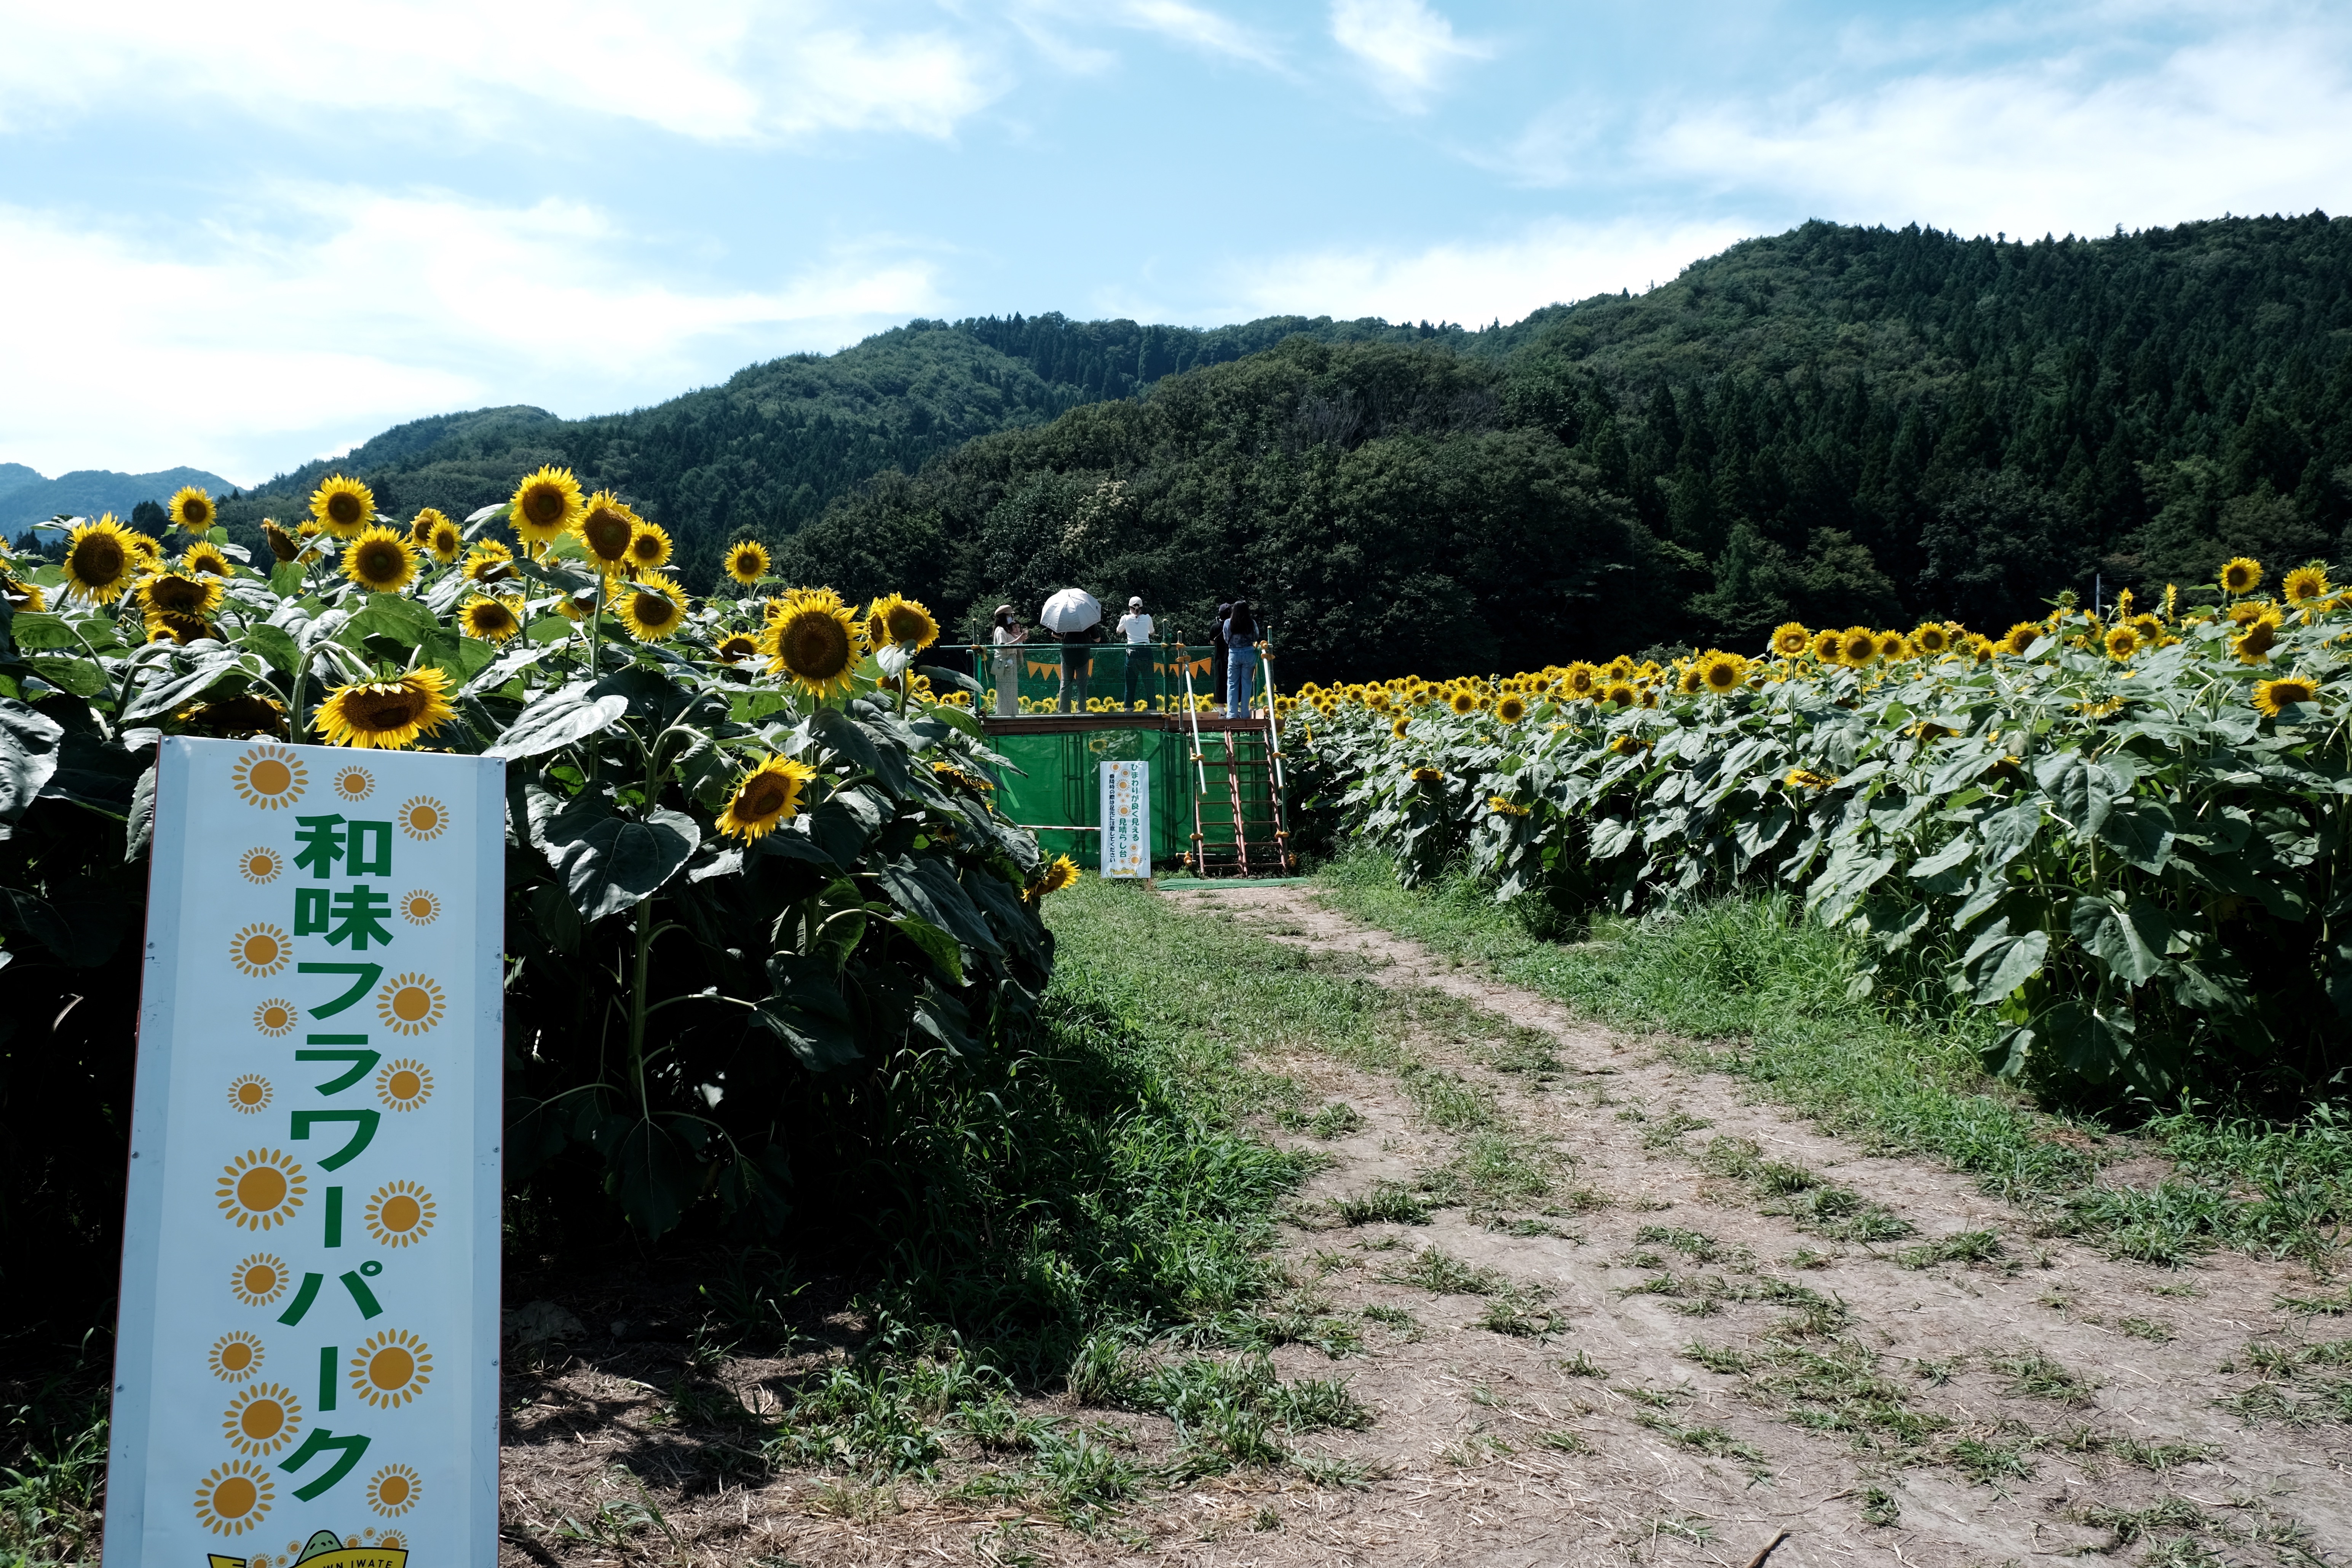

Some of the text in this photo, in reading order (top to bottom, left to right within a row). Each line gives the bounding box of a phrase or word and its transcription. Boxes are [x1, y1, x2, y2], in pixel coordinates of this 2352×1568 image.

[1119, 818, 1127, 857] 見晴らし台
[278, 813, 393, 1502] 和味フラワーパーク
[351, 1559, 393, 1568] IWATE
